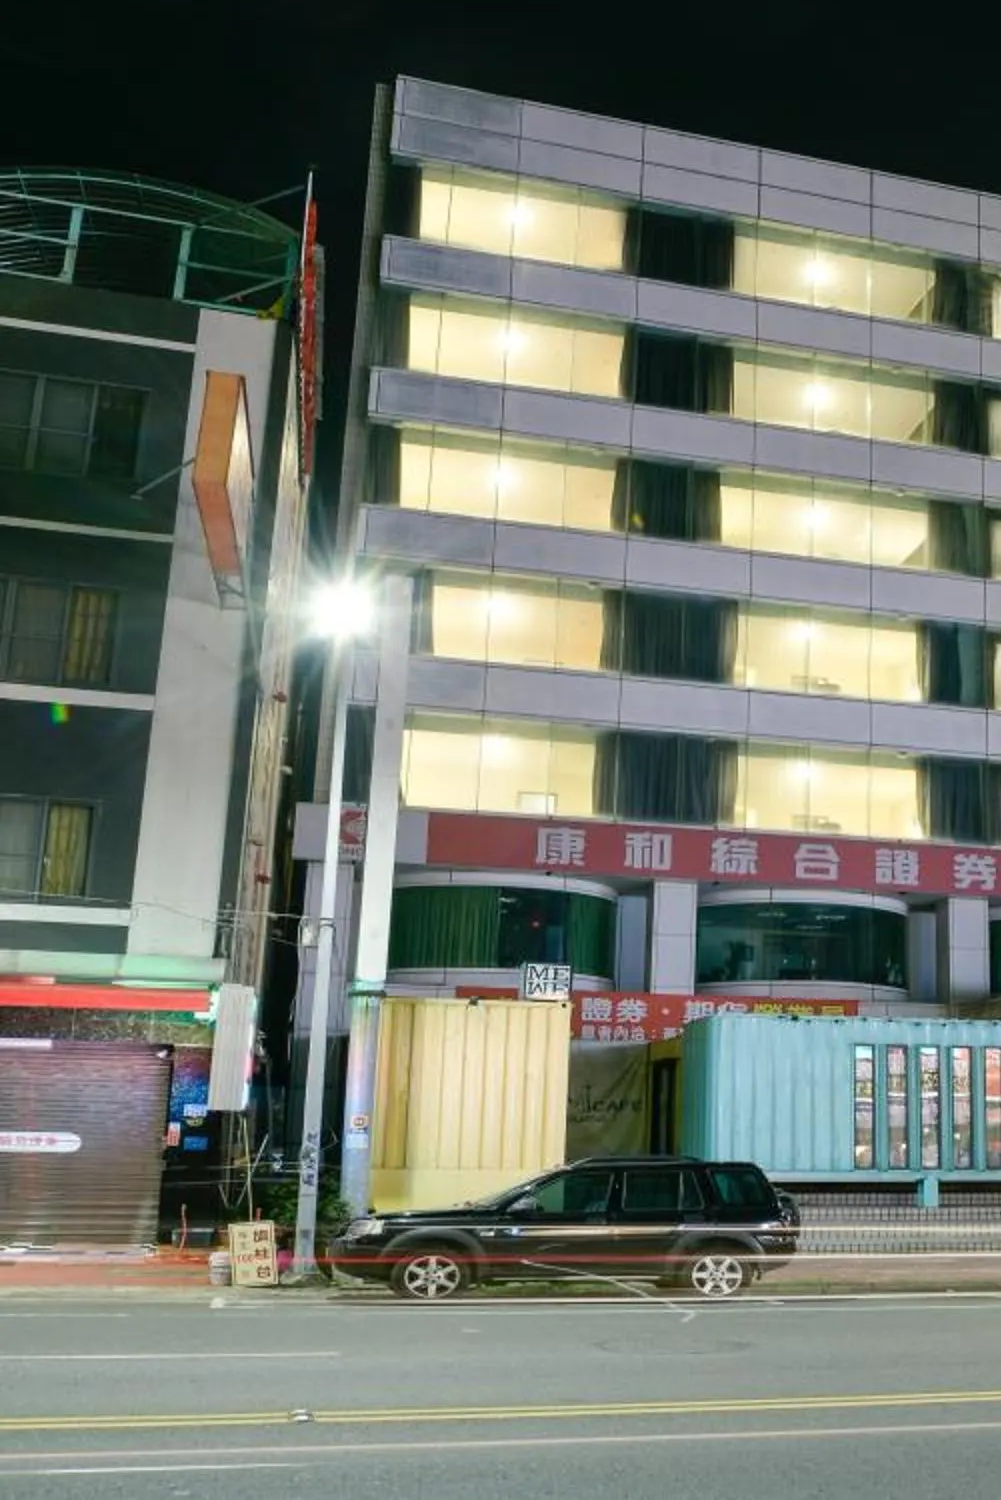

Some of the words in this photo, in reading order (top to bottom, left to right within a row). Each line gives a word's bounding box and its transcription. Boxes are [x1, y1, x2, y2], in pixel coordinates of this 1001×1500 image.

[535, 826, 998, 890] 康和綜合證券
